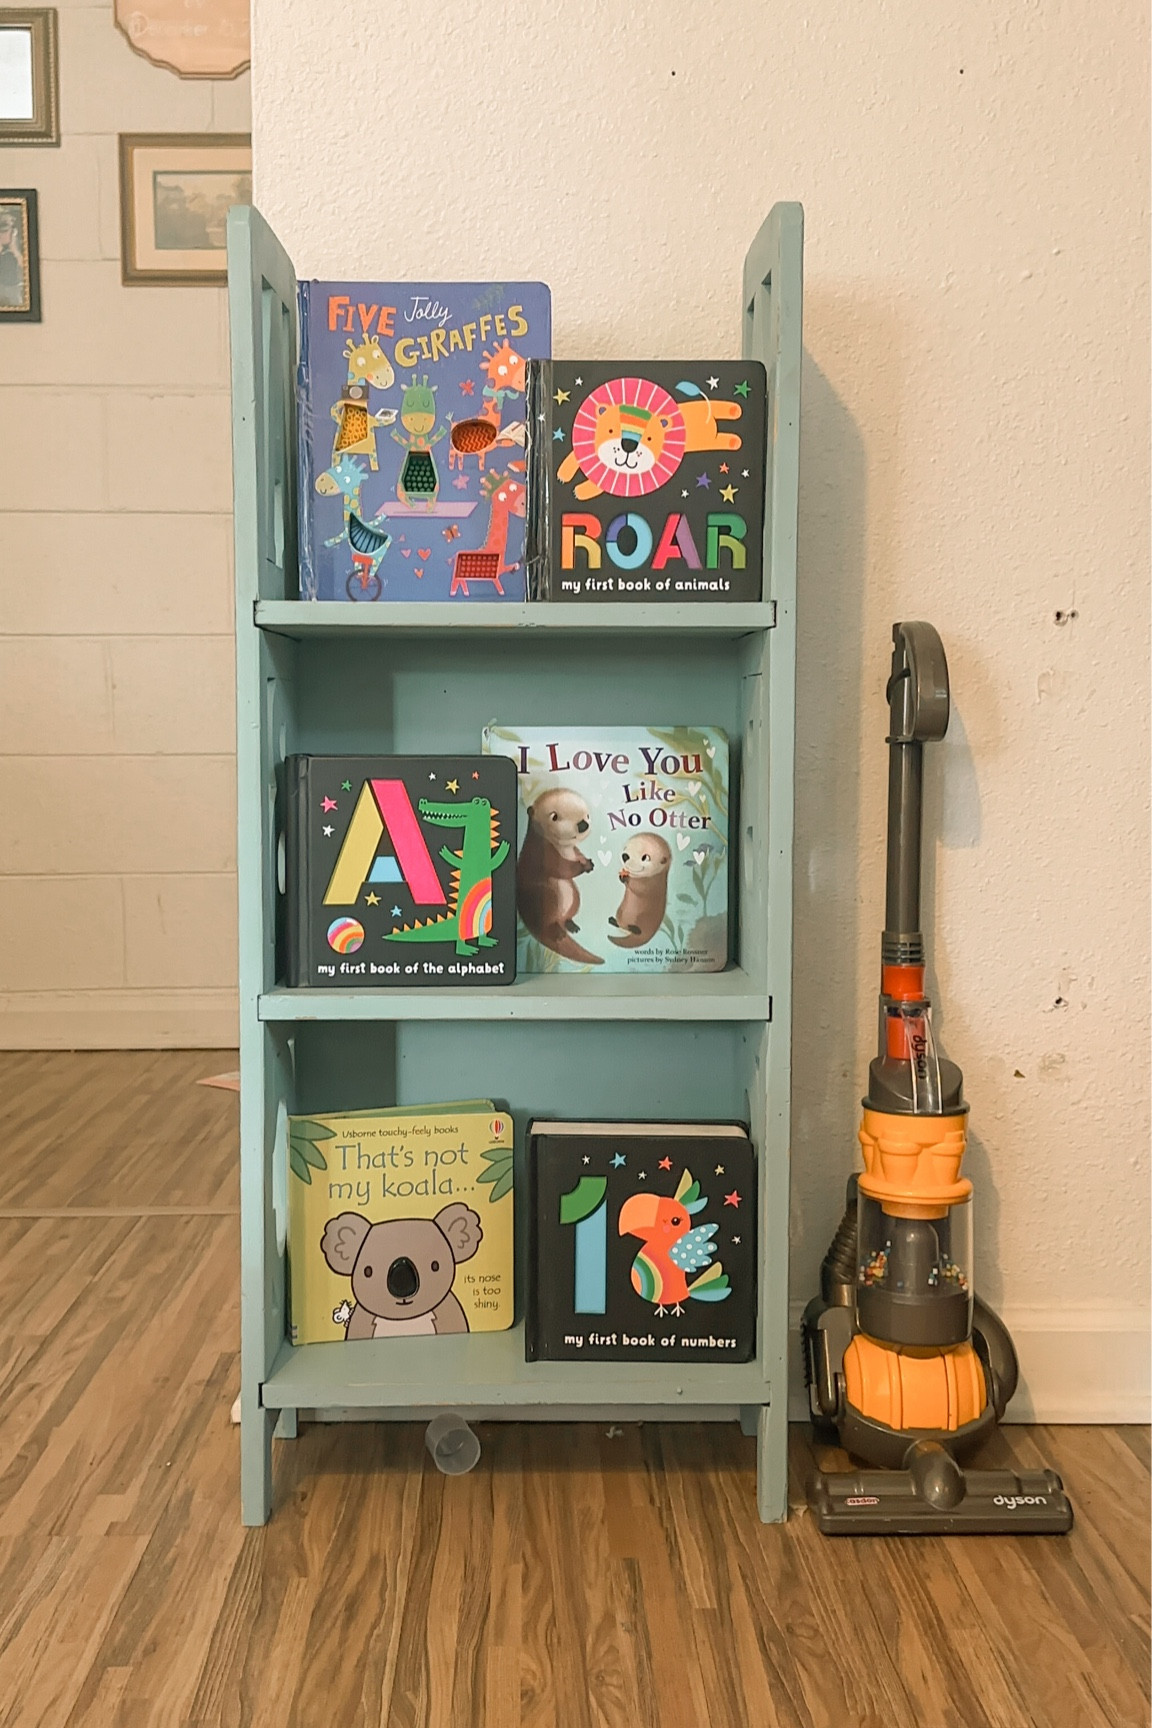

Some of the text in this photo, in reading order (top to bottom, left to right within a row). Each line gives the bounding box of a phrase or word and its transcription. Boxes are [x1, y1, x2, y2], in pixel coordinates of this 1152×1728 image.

[328, 296, 452, 337] FIVE Jolly
[394, 305, 529, 368] GIRAFFES
[561, 513, 747, 570] ROAR
[561, 577, 730, 594] my first book of animals
[517, 743, 704, 776] I Love You
[622, 780, 676, 804] Like
[607, 807, 712, 832] No Otter
[322, 779, 448, 905] A
[655, 956, 663, 965] by
[656, 948, 663, 956] by
[317, 962, 505, 977] my first book of the alphabet
[911, 1034, 928, 1079] dyson
[341, 1125, 459, 1139] Usborne touchy-feely books
[335, 1142, 469, 1171] That's not
[328, 1168, 475, 1206] my koala...
[560, 1176, 607, 1314] 1
[463, 1274, 501, 1284] its nose
[472, 1286, 501, 1296] is too
[564, 1333, 737, 1349] my first book of numbers
[993, 1494, 1047, 1509] dyson
